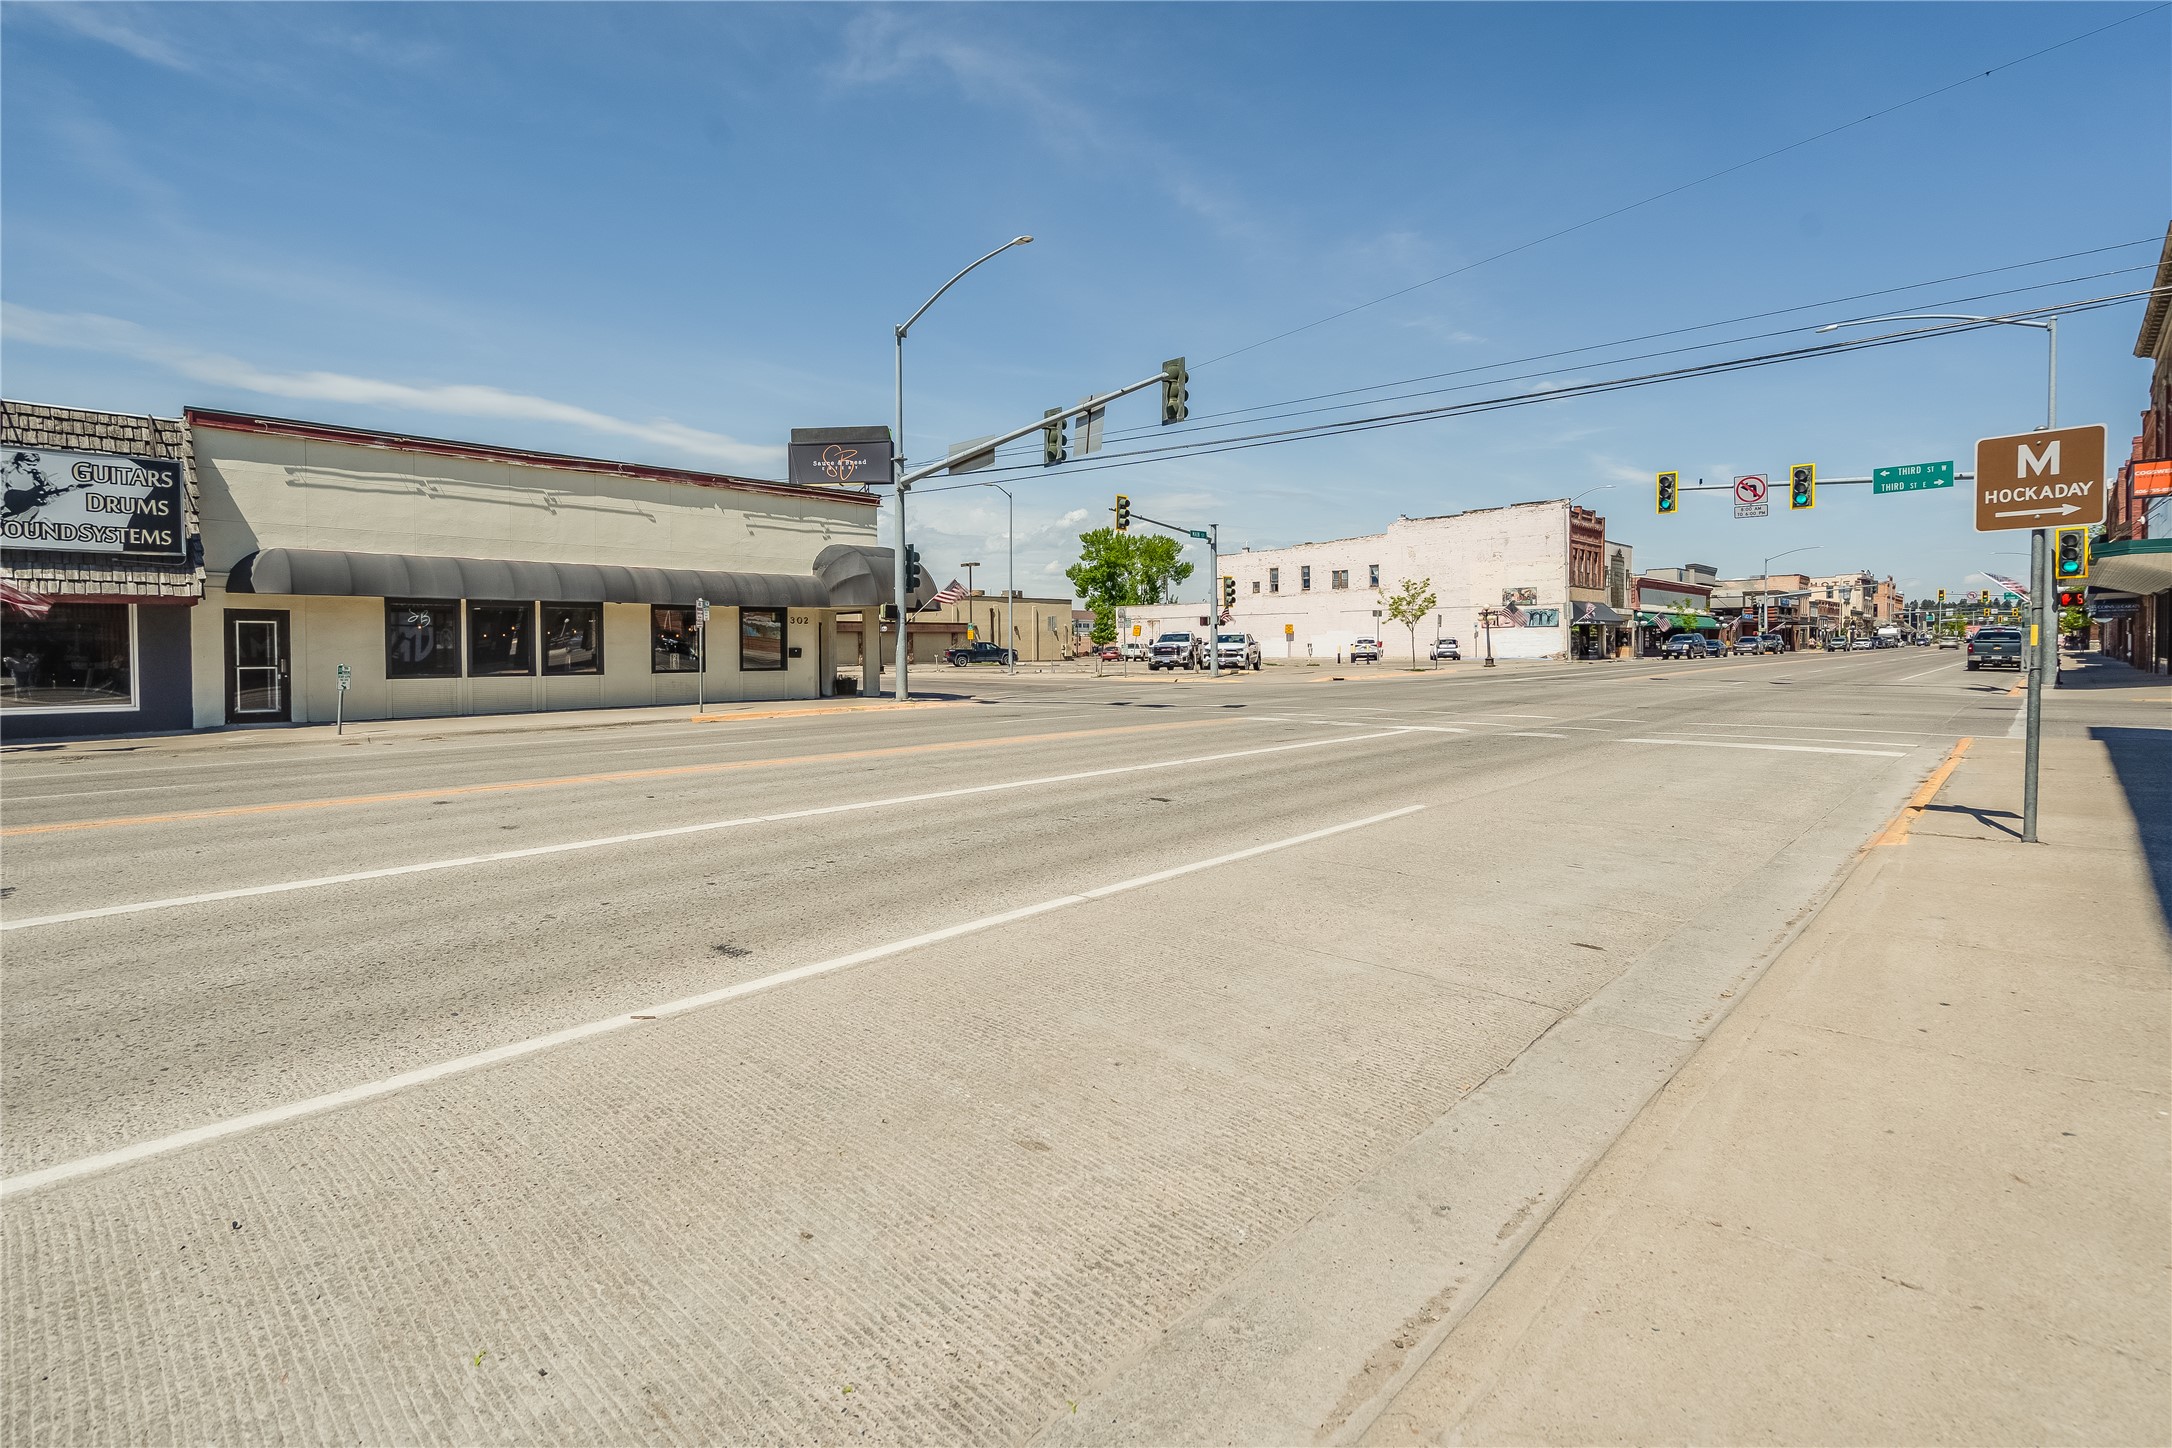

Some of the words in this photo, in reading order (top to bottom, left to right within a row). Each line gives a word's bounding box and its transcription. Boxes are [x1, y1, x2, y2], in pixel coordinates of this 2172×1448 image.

[1898, 466, 1922, 476] THIRD
[2017, 440, 2060, 479] M
[72, 462, 173, 488] GUITARS
[1881, 482, 1905, 491] THIRD
[86, 492, 169, 516] DRUMS
[1984, 480, 2095, 504] HOCKADAY
[0, 521, 172, 545] OUNDSYSTEMS
[2076, 593, 2084, 605] 5
[790, 616, 809, 625] 302
